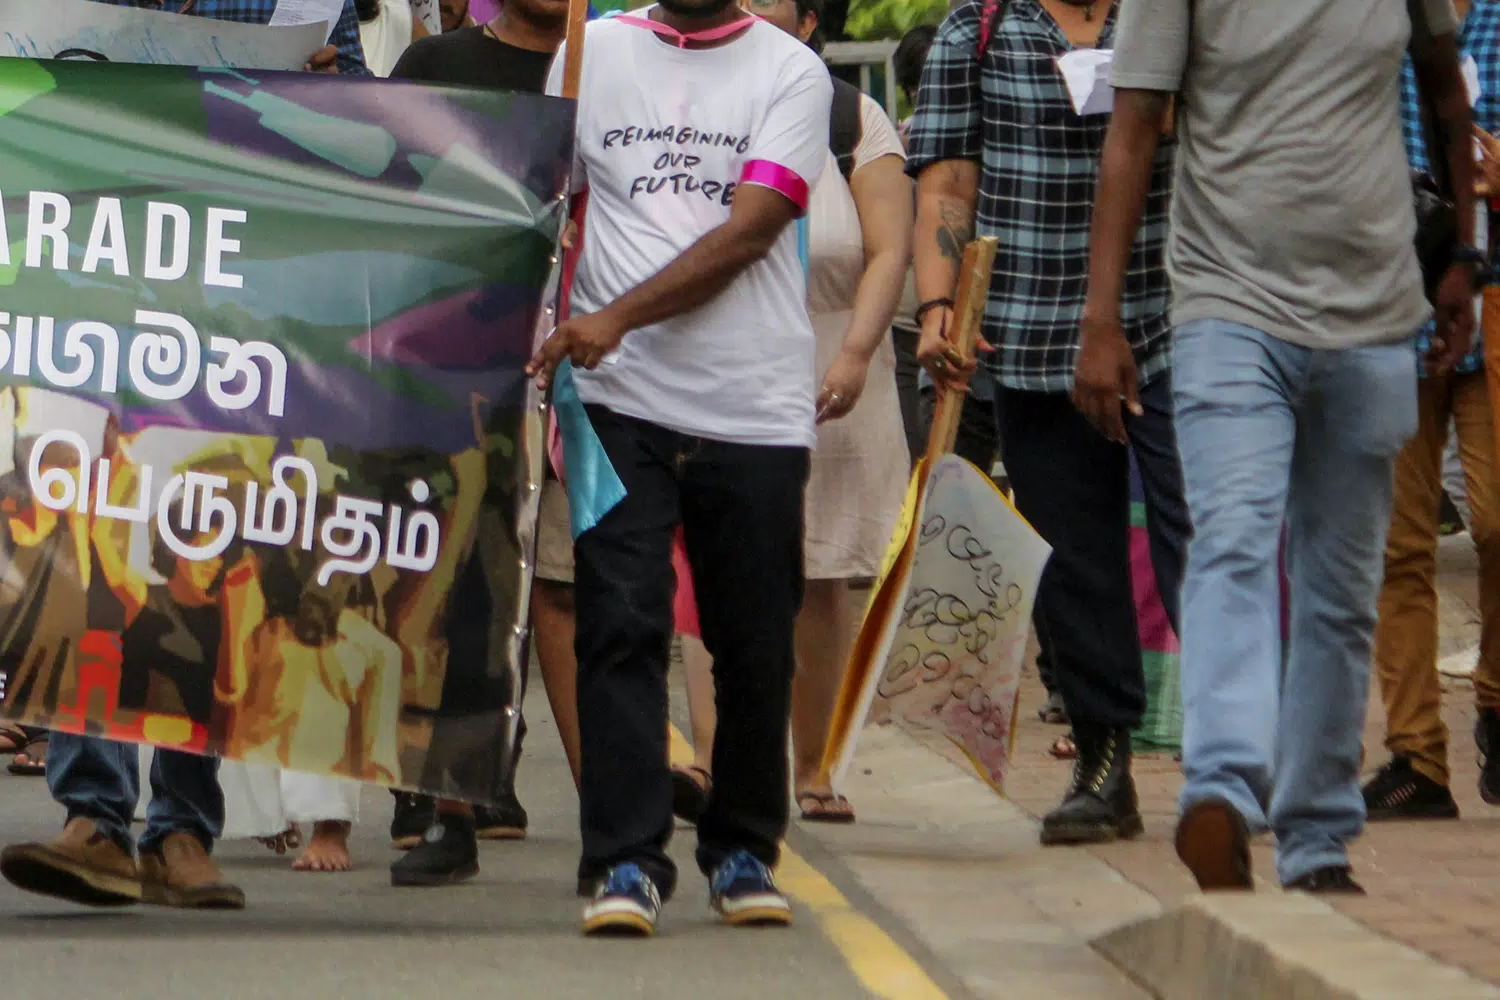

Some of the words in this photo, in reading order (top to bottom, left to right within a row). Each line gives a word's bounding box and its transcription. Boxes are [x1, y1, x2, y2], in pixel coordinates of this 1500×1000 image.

[603, 125, 751, 154] REIMAGINING
[630, 173, 737, 206] FUTURE
[30, 430, 440, 585] பெருமிதம்
